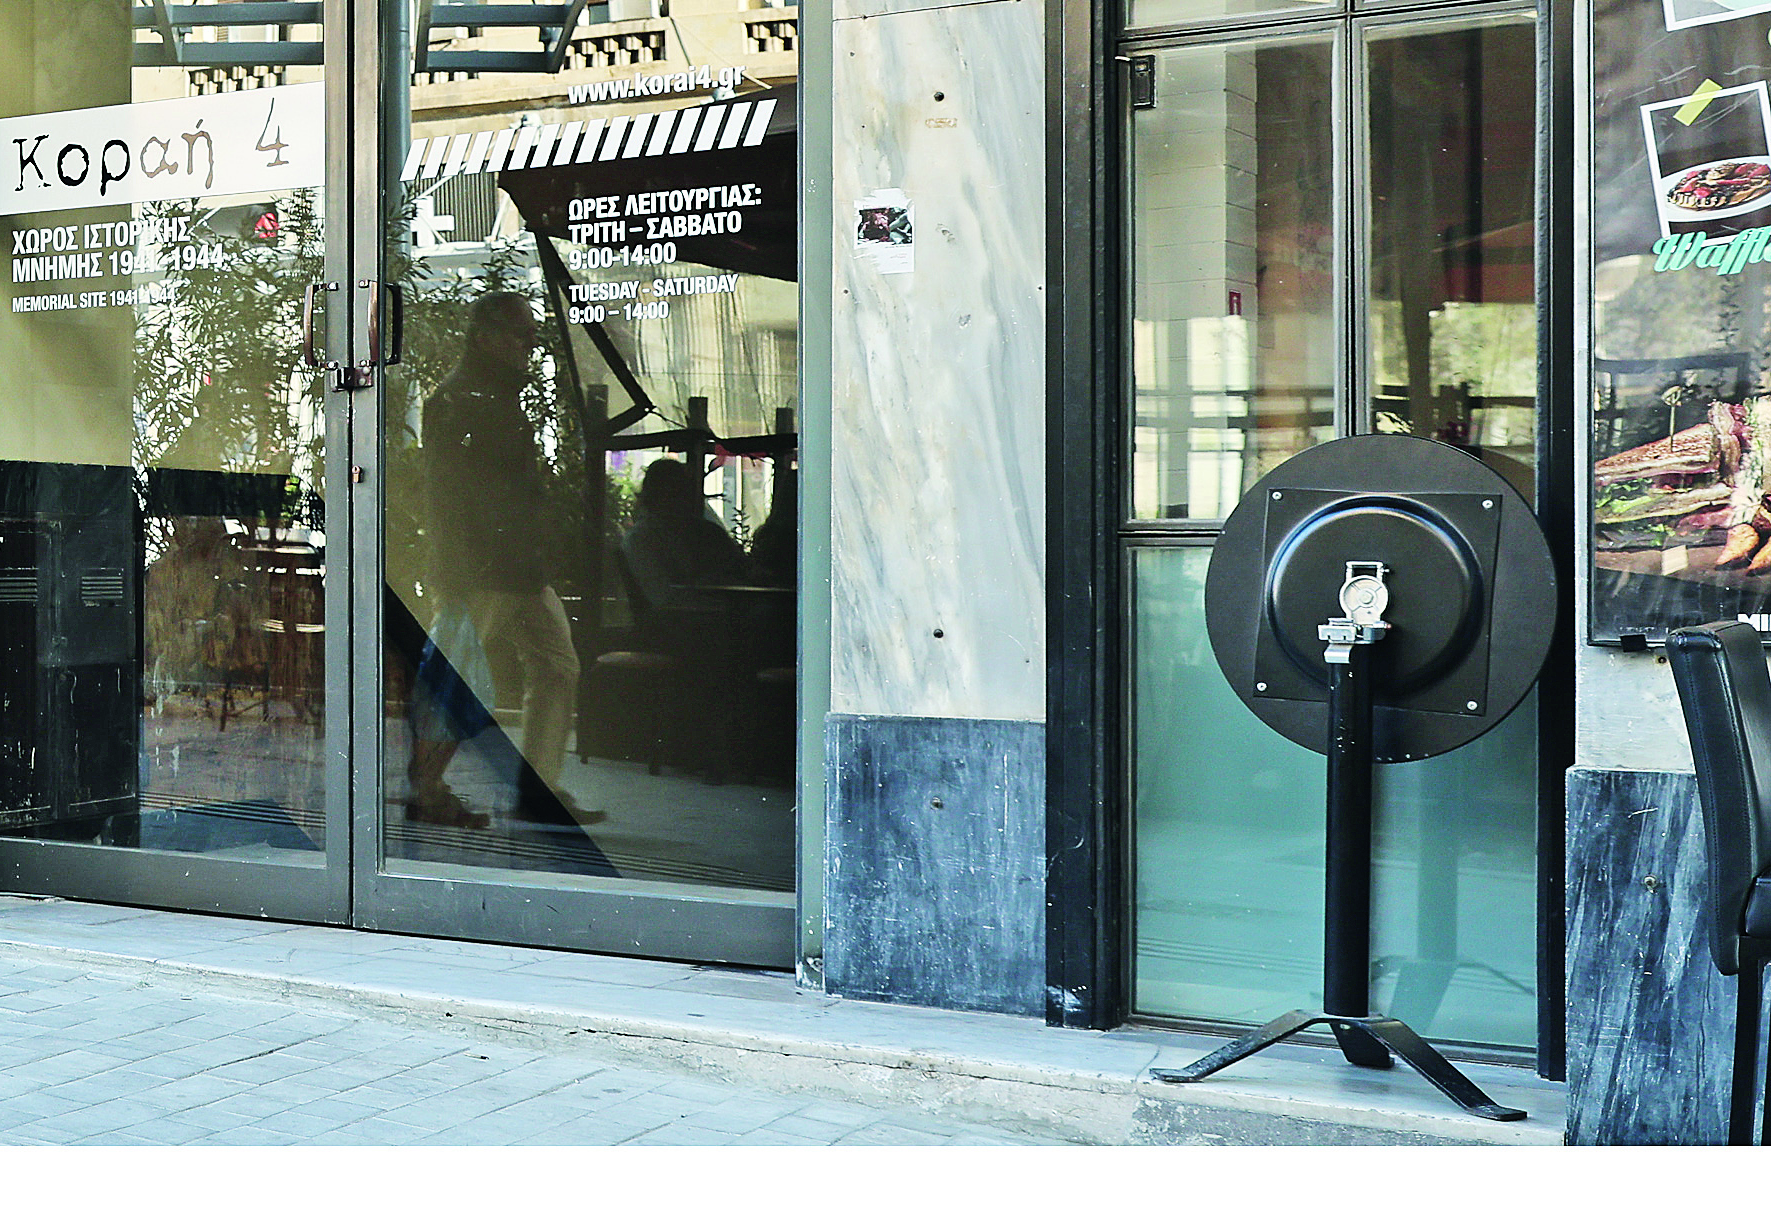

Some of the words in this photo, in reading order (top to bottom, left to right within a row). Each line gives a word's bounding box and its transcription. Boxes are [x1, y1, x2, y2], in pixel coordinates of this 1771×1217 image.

[568, 65, 746, 104] www.korai4.gr
[13, 119, 216, 197] Κοραή
[256, 97, 290, 167] 4
[569, 196, 620, 221] ΩΡΕΣ
[625, 184, 762, 216] ΛΕΙΤΟΥΡΓΙΑΣ:
[12, 226, 78, 255] ΧΩΡΟΣ
[84, 216, 191, 249] ΙΣΤΟΡΙΚΗΣ
[568, 221, 626, 244] ΤΡΙΤΗ
[646, 211, 742, 239] ΣΑΒΒΑΤΟ
[12, 252, 103, 283] ΜΝΗΜΗΣ
[569, 242, 677, 270] 9:00-14:00
[12, 294, 77, 313] MEMORIAL
[80, 291, 107, 308] SITE
[569, 281, 639, 302] TUESDAY
[653, 274, 739, 297] SATURDAY
[569, 305, 605, 324] 9:00
[624, 301, 669, 321] 14:00
